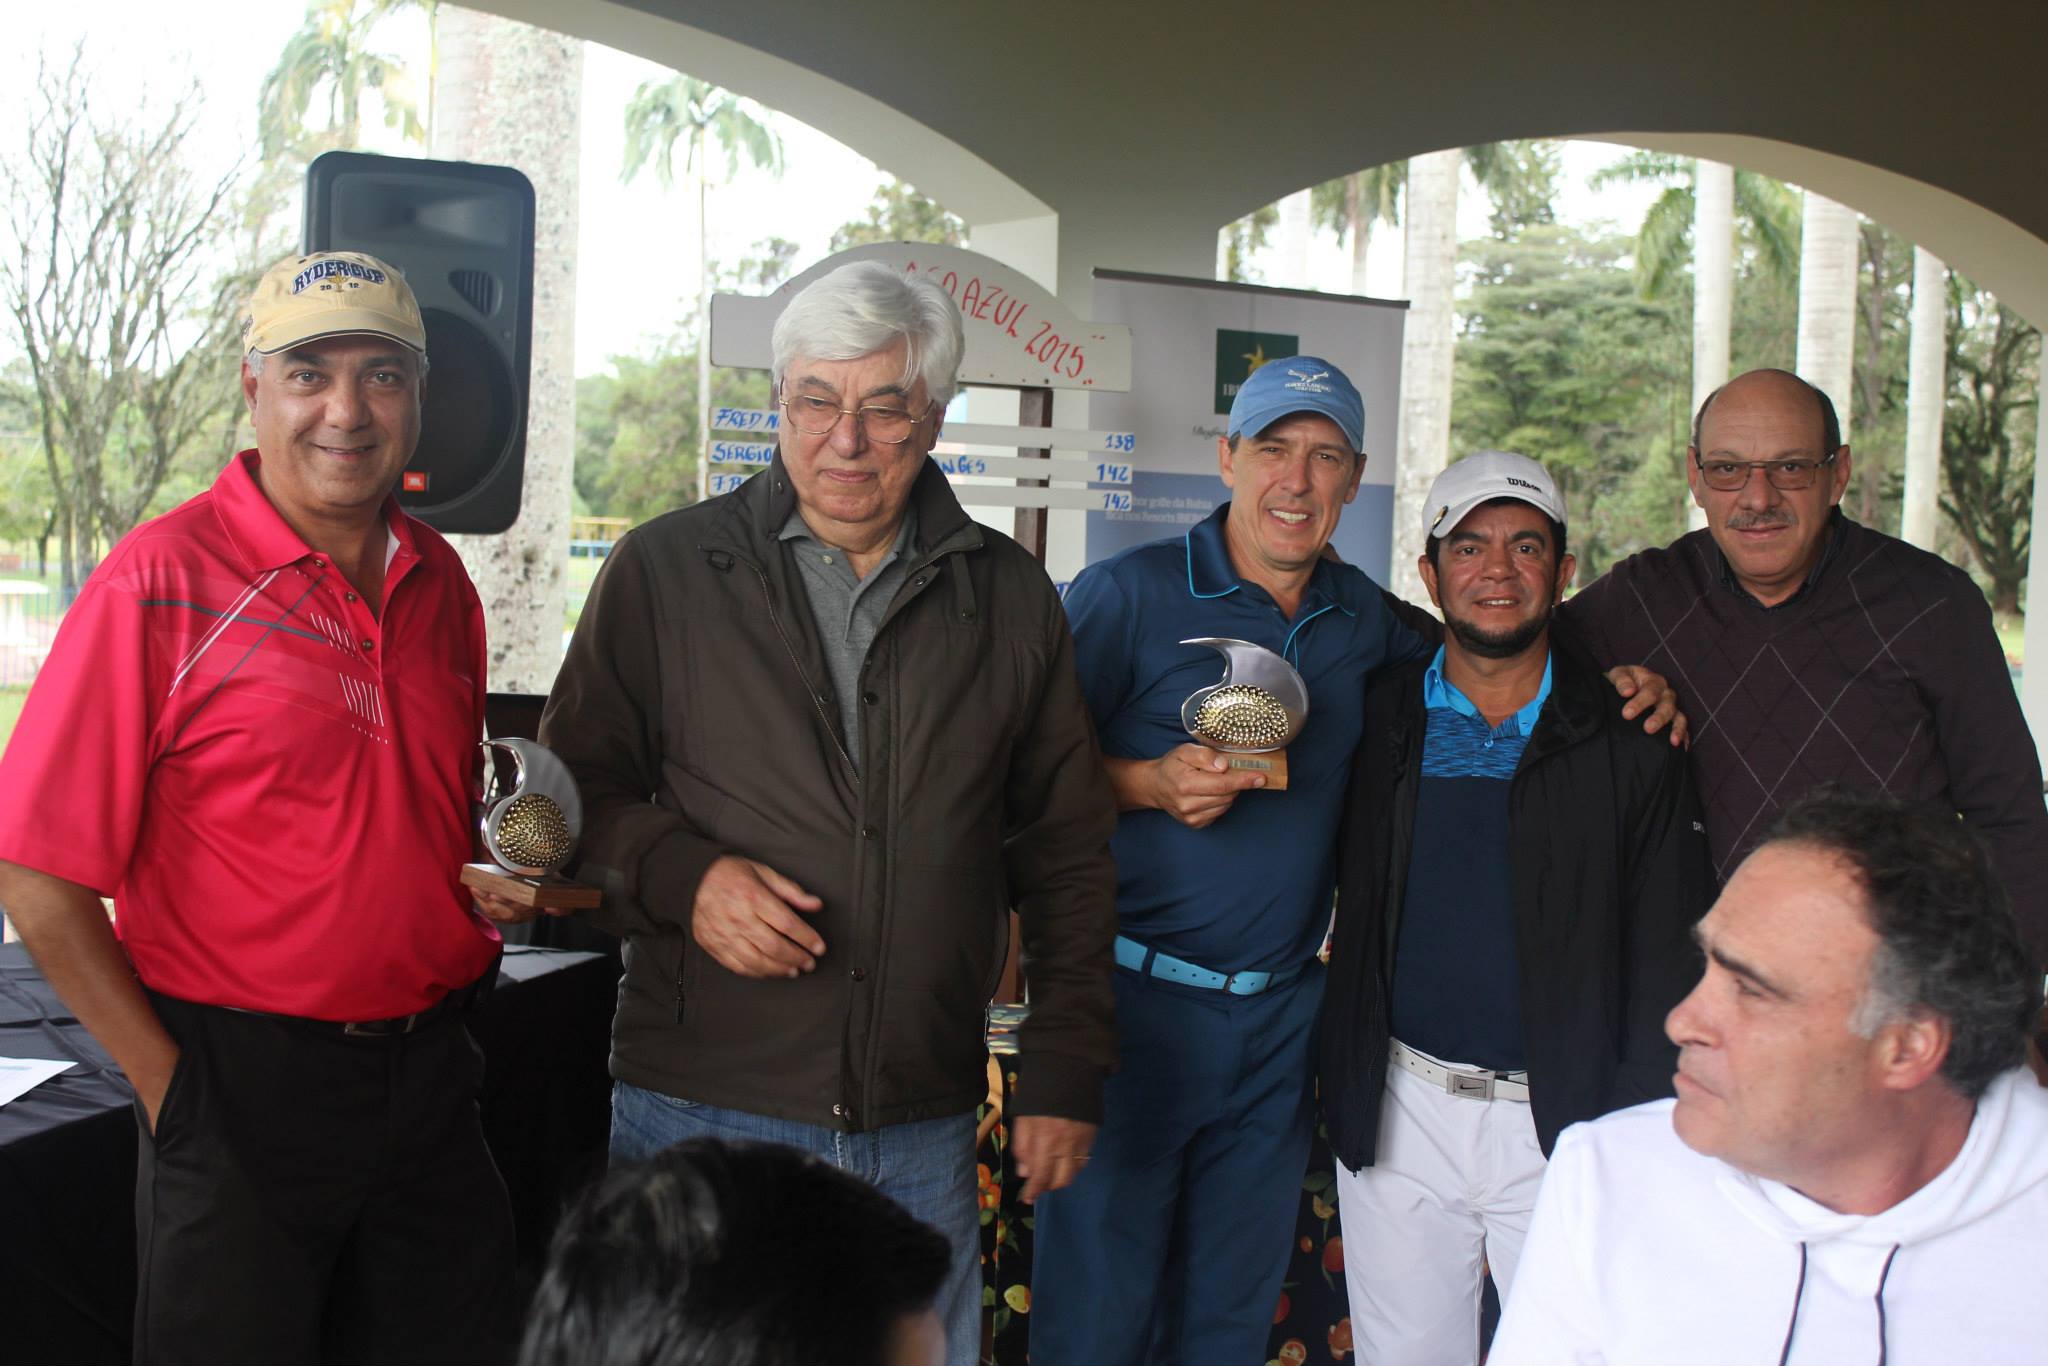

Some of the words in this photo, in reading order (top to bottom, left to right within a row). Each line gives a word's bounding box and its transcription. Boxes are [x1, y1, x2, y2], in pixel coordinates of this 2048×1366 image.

[961, 277, 1029, 338] AZUL
[714, 408, 763, 429] FRED
[1106, 433, 1135, 451] 138
[1096, 463, 1129, 482] 142
[1507, 477, 1543, 493] Wilson
[1103, 493, 1131, 510] 142
